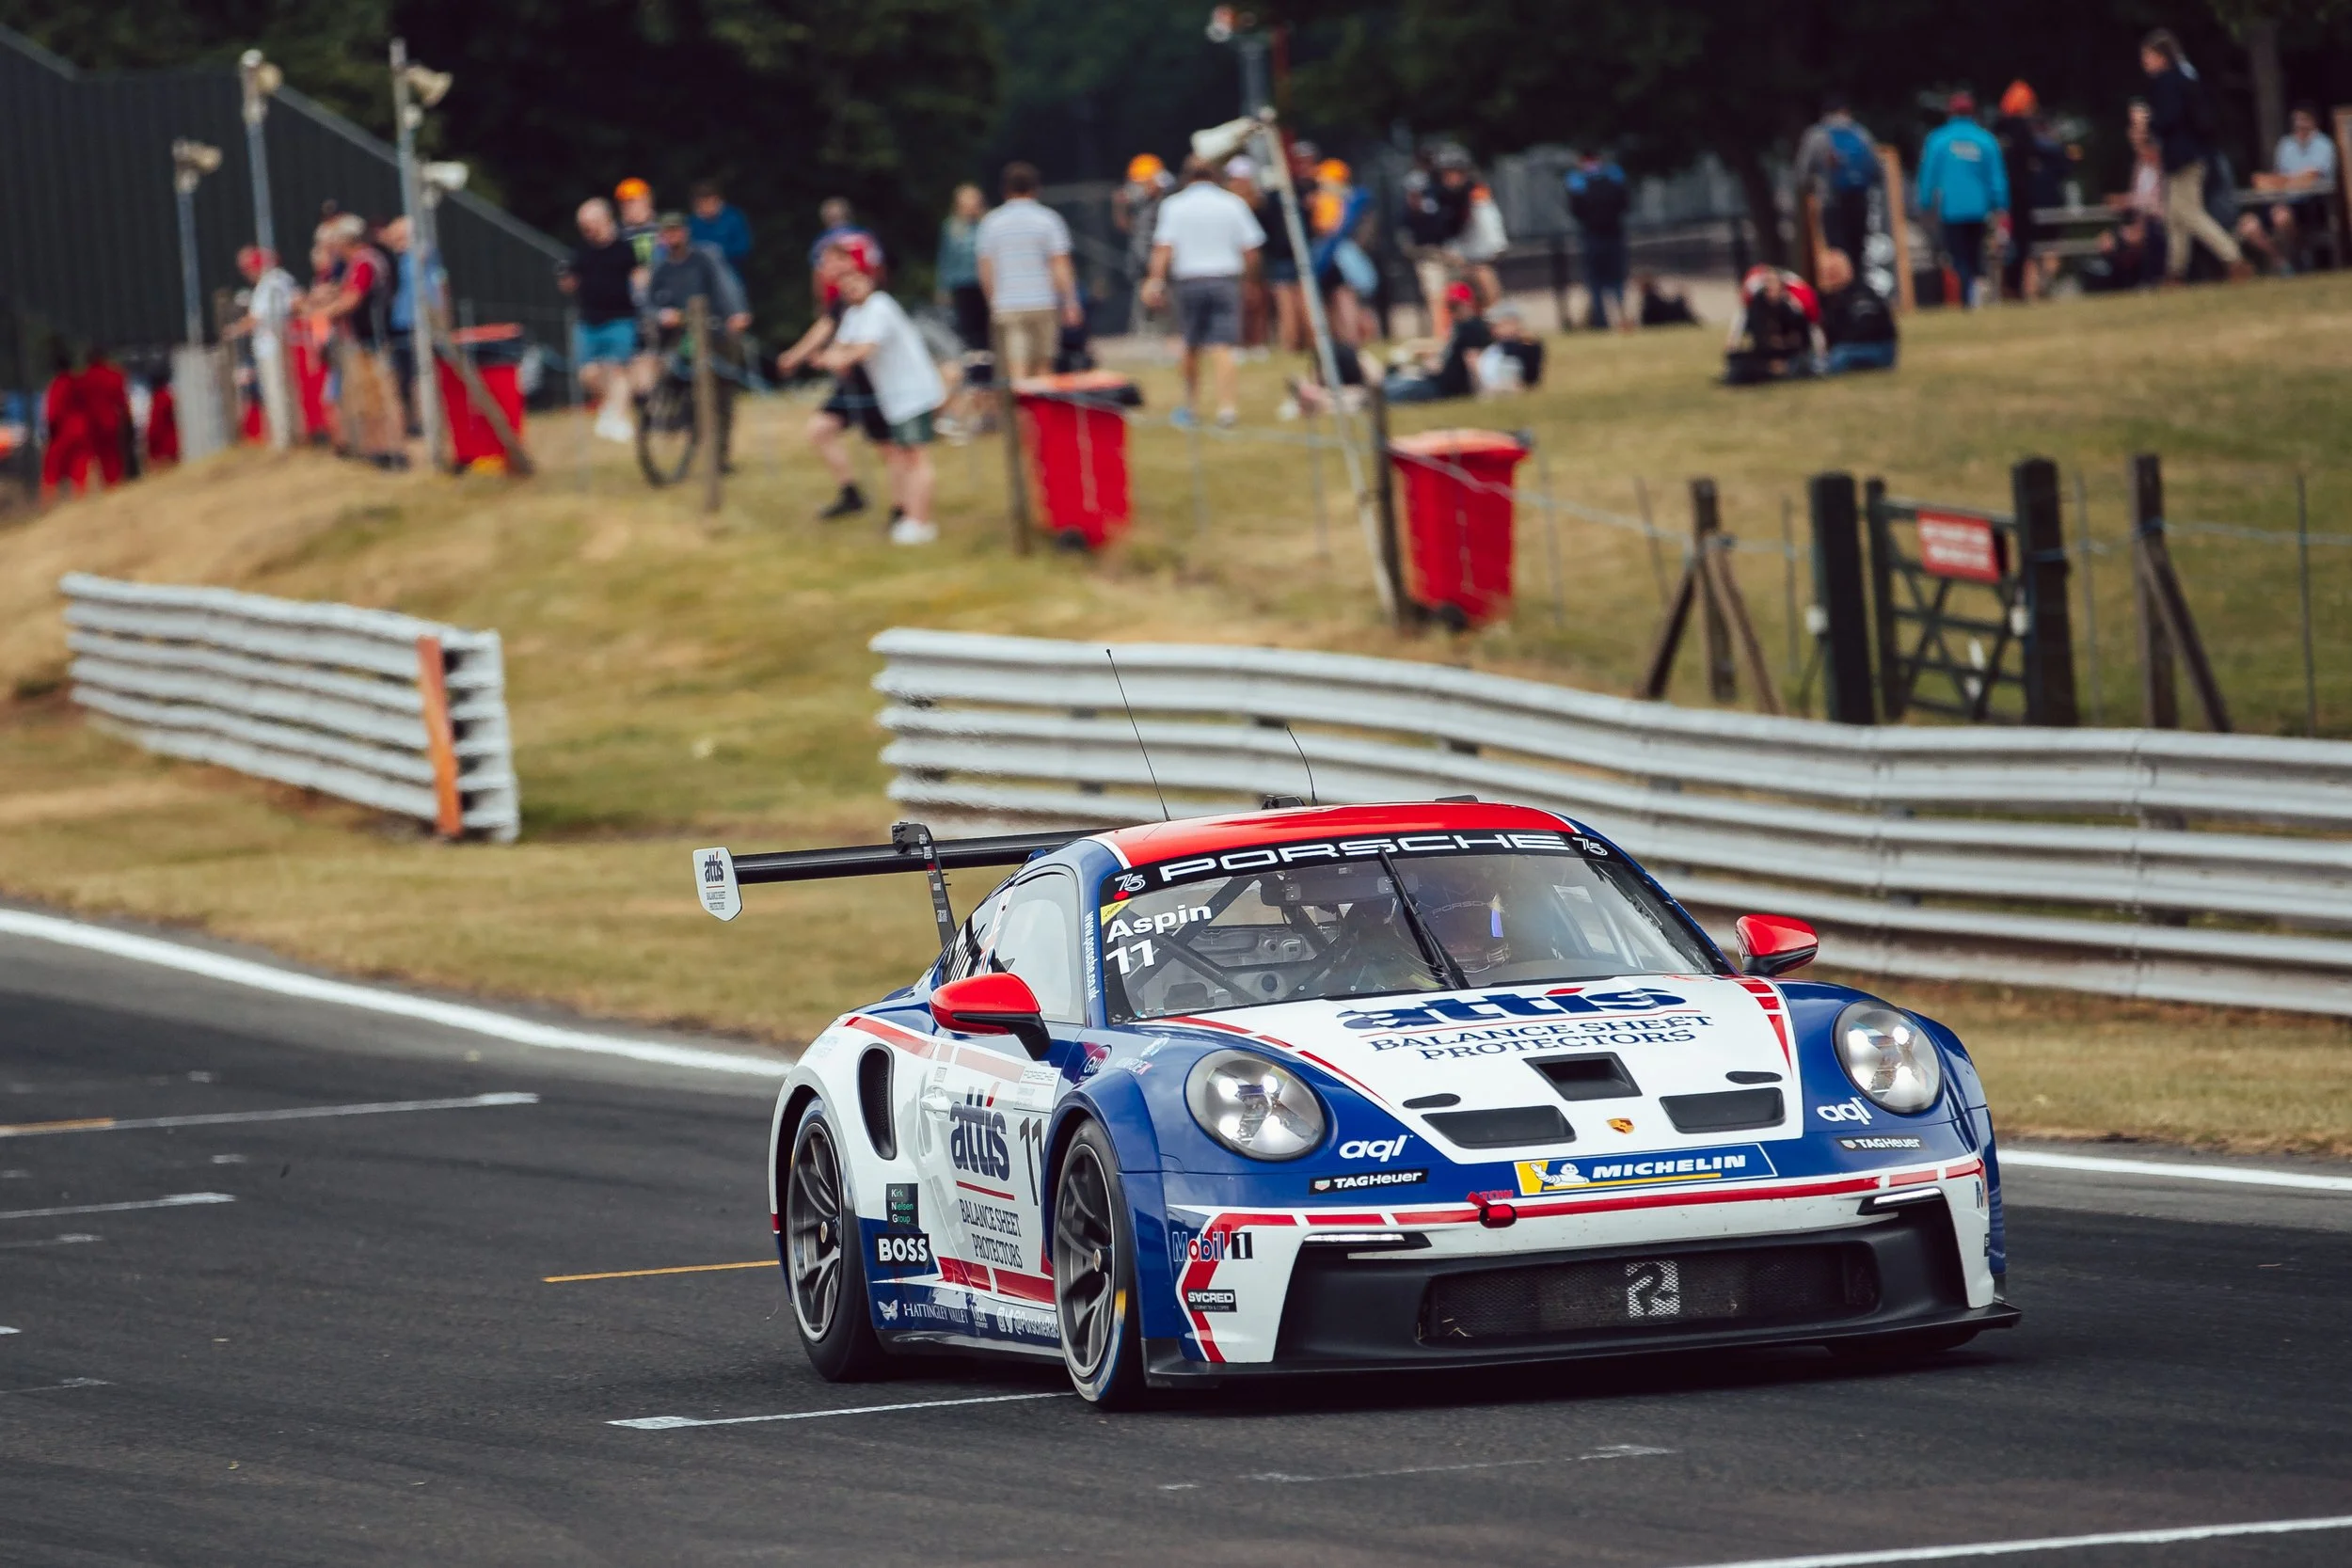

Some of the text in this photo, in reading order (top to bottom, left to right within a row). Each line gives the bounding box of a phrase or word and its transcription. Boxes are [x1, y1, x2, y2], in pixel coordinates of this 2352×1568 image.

[1158, 833, 1570, 882] PORSCHE
[1571, 836, 1608, 857] 75
[704, 850, 724, 882] attis
[1114, 873, 1146, 892] 75
[1106, 904, 1213, 943] Aspin
[1084, 911, 1100, 1003] www.porsche.co.uk
[1105, 939, 1155, 975] 11
[1336, 987, 1687, 1030] attis
[1370, 1016, 1714, 1053] BALANCE SHEET
[1415, 1029, 1697, 1060] PROTECTORS
[1817, 1096, 1873, 1126] aql
[949, 1081, 1010, 1181] attis
[1339, 1134, 1409, 1163] aql
[1592, 1154, 1747, 1179] MICHELIN
[891, 1188, 903, 1197] Kirk
[891, 1202, 914, 1211] Nielsen
[892, 1214, 911, 1224] Group
[958, 1199, 1022, 1238] BALANCE SHEET
[878, 1238, 928, 1261] BOSS
[971, 1233, 1024, 1269] PROTECTORS
[1172, 1231, 1225, 1261] Mobil
[1187, 1291, 1234, 1303] SACRED
[903, 1303, 969, 1323] HATTINGLEY VALLEY
